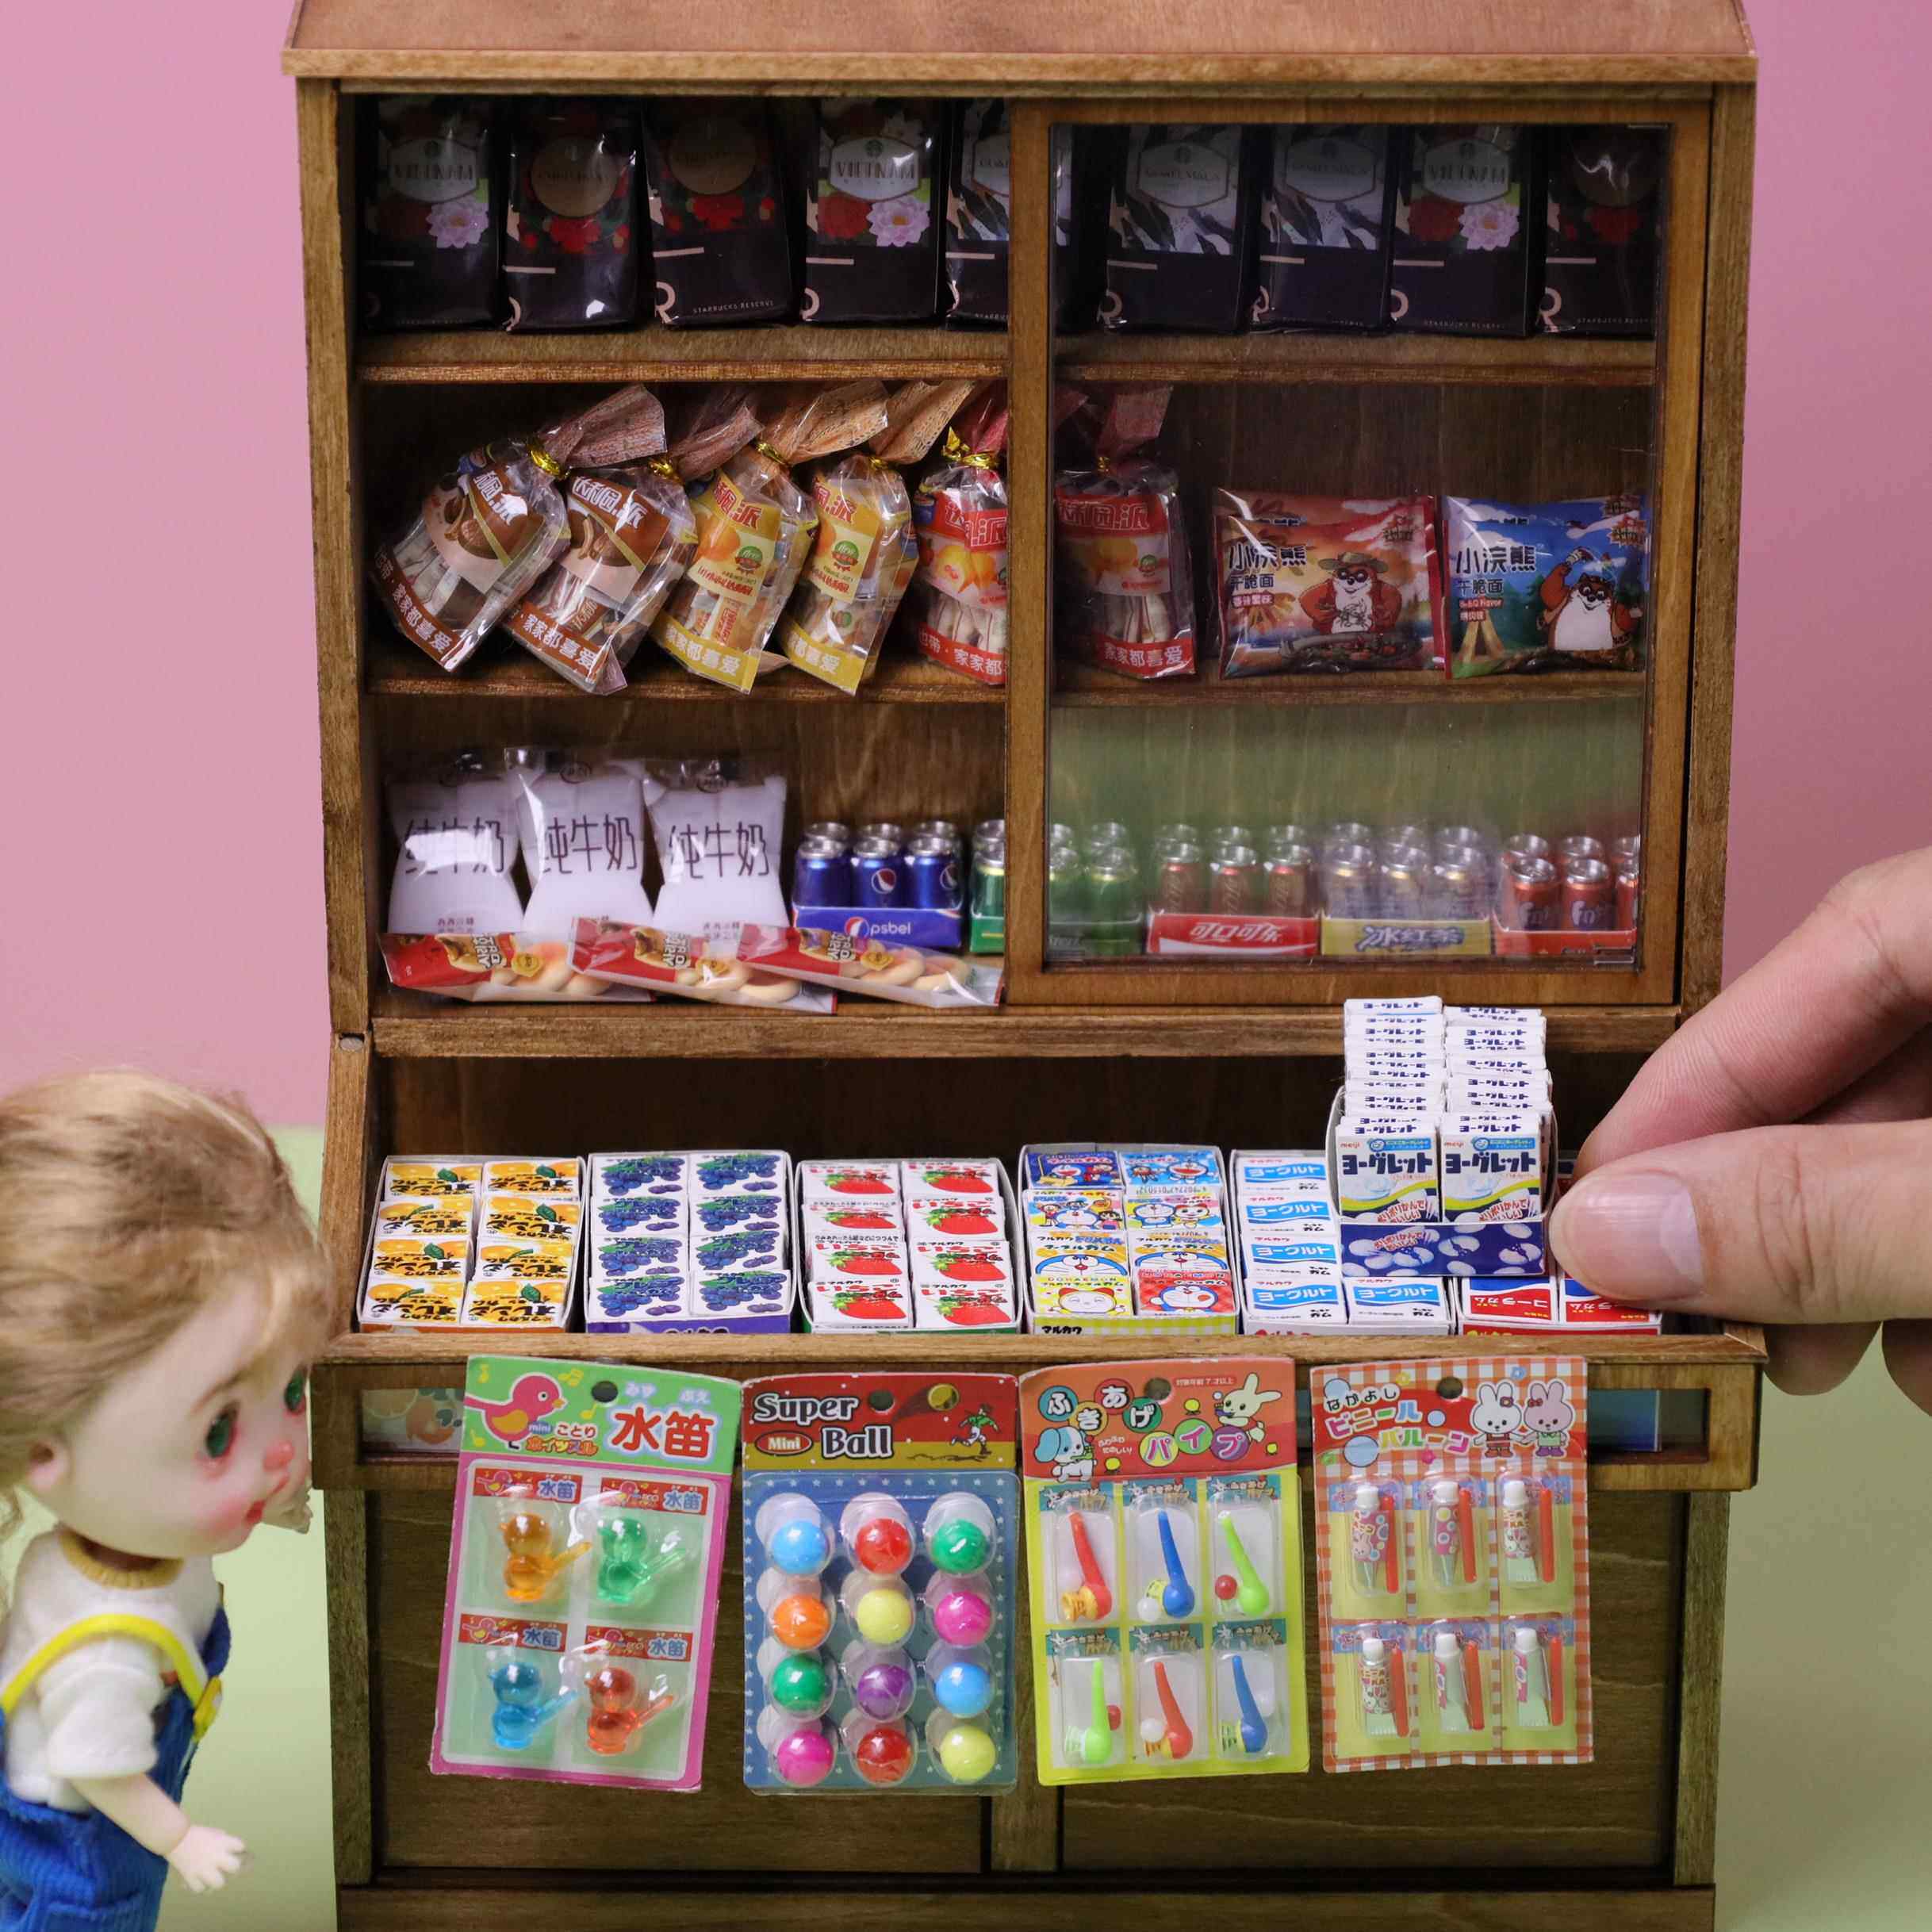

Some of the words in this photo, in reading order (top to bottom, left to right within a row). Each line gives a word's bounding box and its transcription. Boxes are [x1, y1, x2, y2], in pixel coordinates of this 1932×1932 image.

[836, 161, 916, 180] VIETNAM
[741, 300, 775, 311] RESERVE
[1455, 544, 1537, 575] 小浣熊
[668, 820, 771, 880] 纯牛奶
[1248, 1165, 1321, 1178] ヨーグルト
[1342, 1152, 1433, 1176] ヨーグレット
[1444, 1151, 1537, 1175] ヨーグレット
[1251, 1203, 1325, 1217] ヨーグルト
[1255, 1246, 1332, 1256] ヨーグルト
[1256, 1288, 1333, 1302] ヨーグルト
[1357, 1288, 1434, 1298] ヨーグルト
[371, 1304, 457, 1316] オレンジ
[468, 1305, 556, 1317] オレンジ
[1041, 1325, 1083, 1335] マルカワ
[1326, 1386, 1398, 1410] なかよし
[753, 1393, 859, 1426] Super
[1325, 1401, 1423, 1438] ビニール
[556, 1424, 597, 1439] ことり
[609, 1405, 715, 1459] 水笛
[1378, 1427, 1470, 1454] バルーン
[767, 1436, 802, 1451] Mini
[822, 1426, 893, 1459] Ball
[1144, 1424, 1244, 1461] パイプ
[539, 1480, 577, 1501] 水笛
[663, 1490, 703, 1512] 水笛
[523, 1627, 560, 1650] 水笛
[649, 1638, 688, 1659] 水笛
